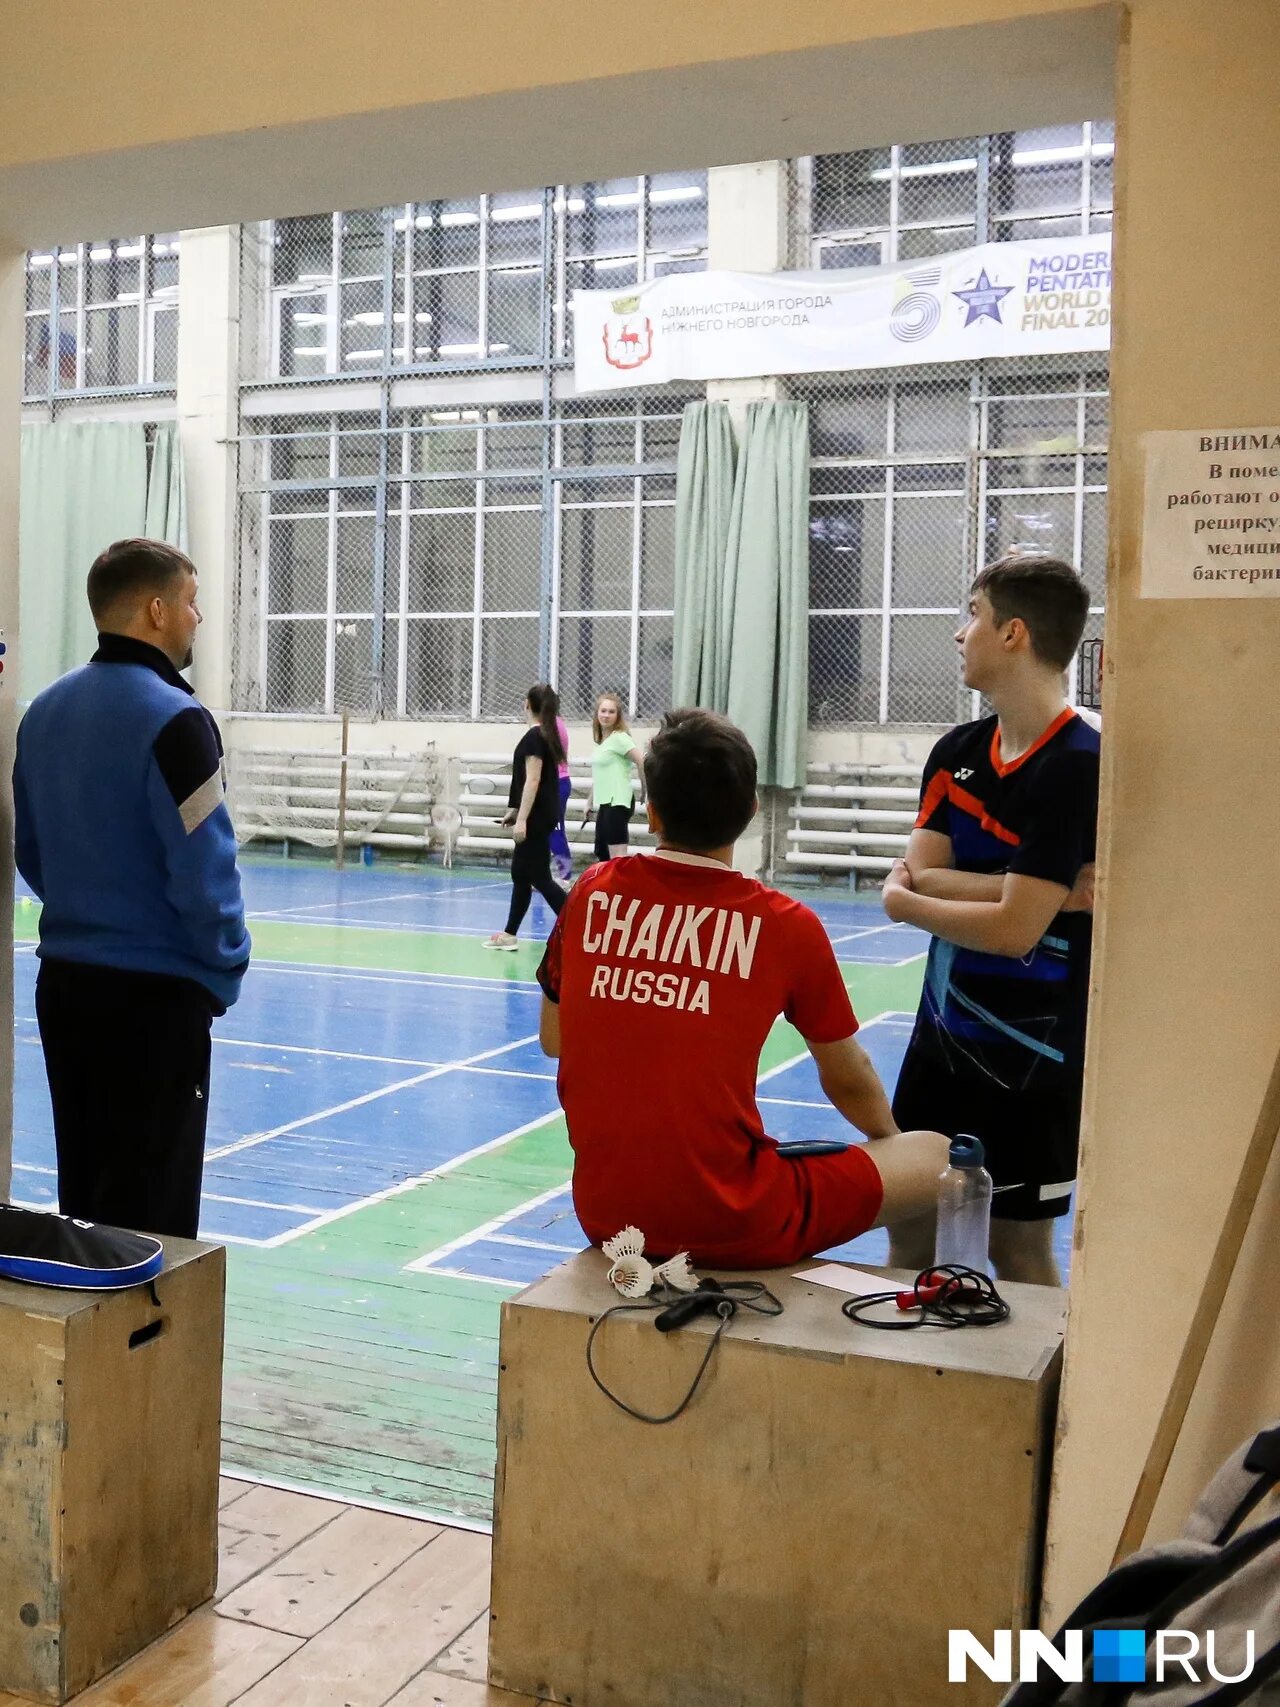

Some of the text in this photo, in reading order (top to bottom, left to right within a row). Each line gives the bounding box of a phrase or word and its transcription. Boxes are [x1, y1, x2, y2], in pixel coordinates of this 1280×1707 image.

[661, 296, 833, 319] АДМИНИСТРАЦИЯ ГОРОДА
[1024, 290, 1101, 312] WORLD
[661, 315, 811, 334] НИЖНЕГО НОВГОРОДА
[1021, 311, 1079, 331] FINAL
[1209, 464, 1278, 479] В поме
[1167, 490, 1263, 510] работают
[1194, 517, 1279, 534] рецирку
[582, 890, 763, 980] CHAIKIN
[589, 965, 710, 1015] RUSSIA
